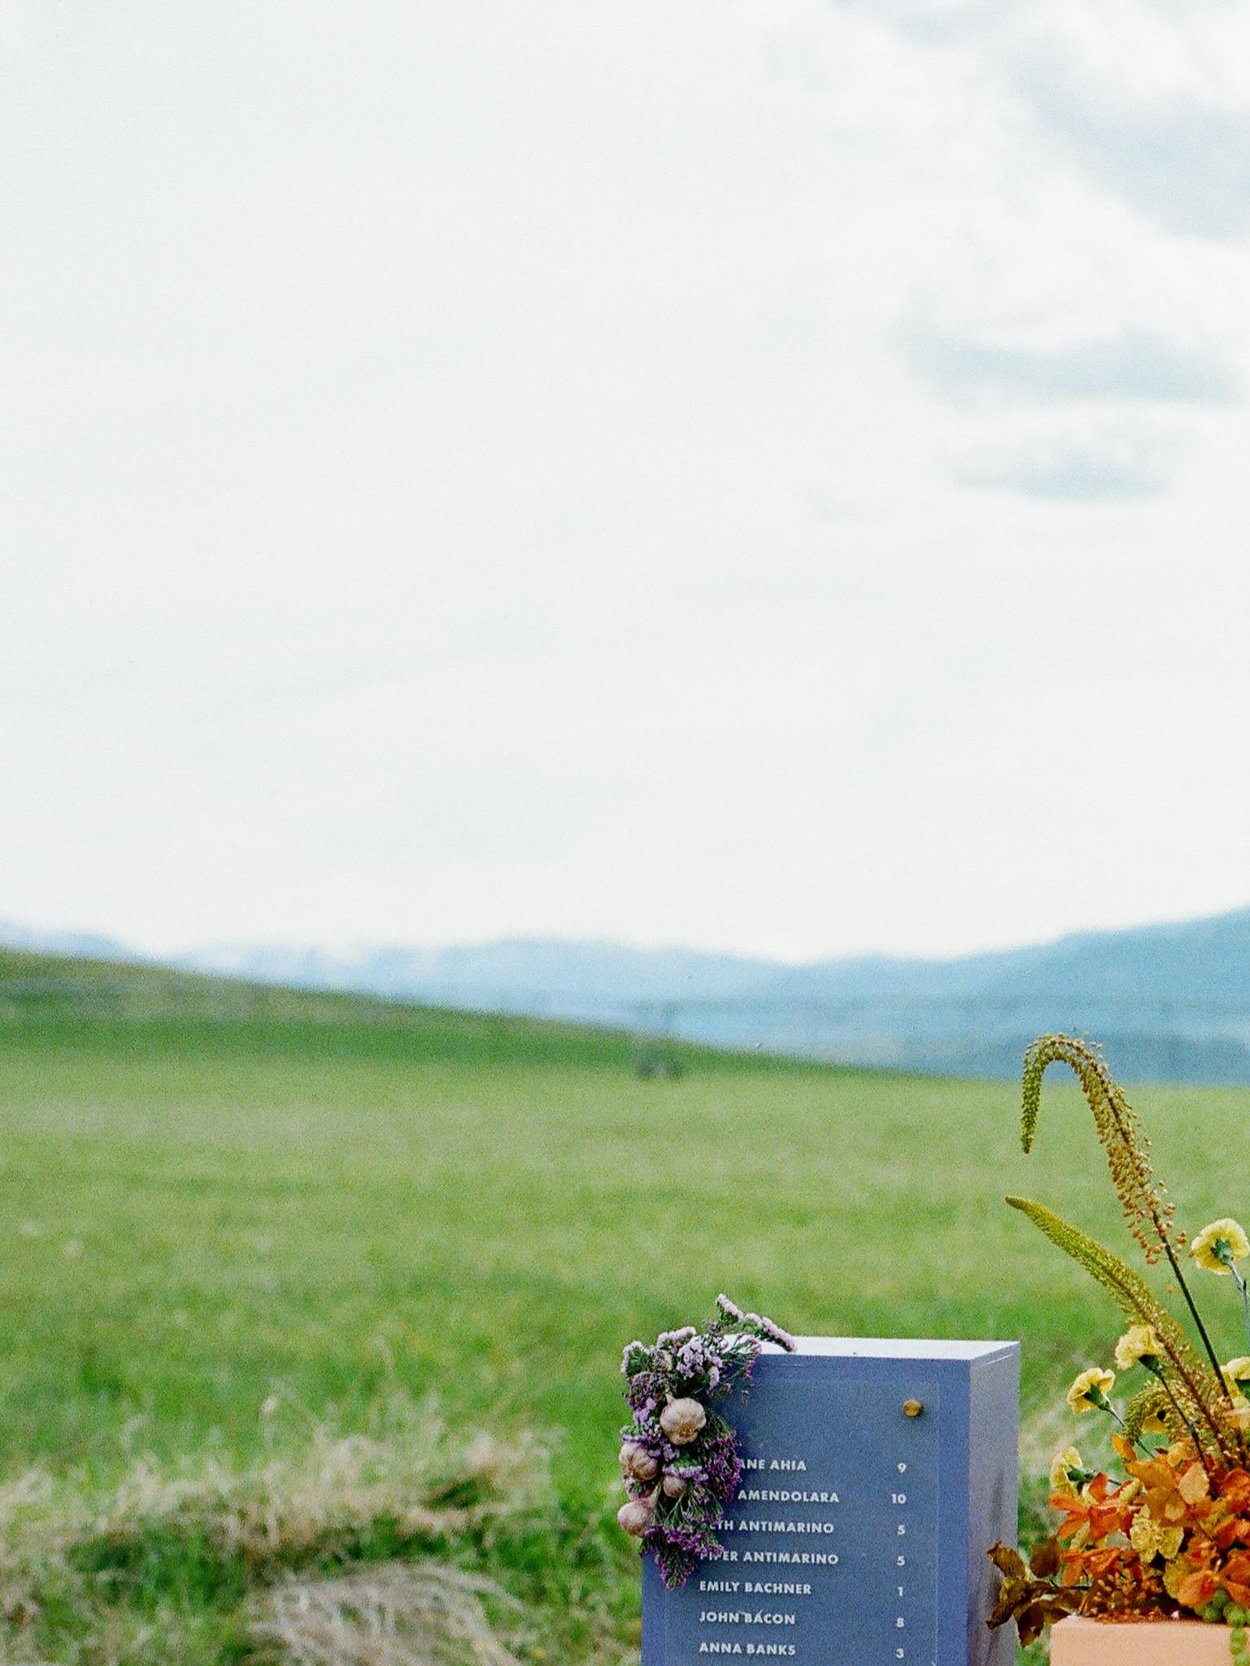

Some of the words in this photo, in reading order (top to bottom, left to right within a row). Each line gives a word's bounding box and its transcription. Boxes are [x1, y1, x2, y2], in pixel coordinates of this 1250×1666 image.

[737, 1489, 840, 1503] AMENDOLARA
[891, 1492, 907, 1505] 10
[699, 1580, 741, 1592] EMILY
[744, 1581, 812, 1595] BACHNER
[897, 1586, 904, 1597] 1
[698, 1641, 742, 1654] ANNA
[746, 1642, 796, 1656] BANKS
[895, 1647, 905, 1659] 3
